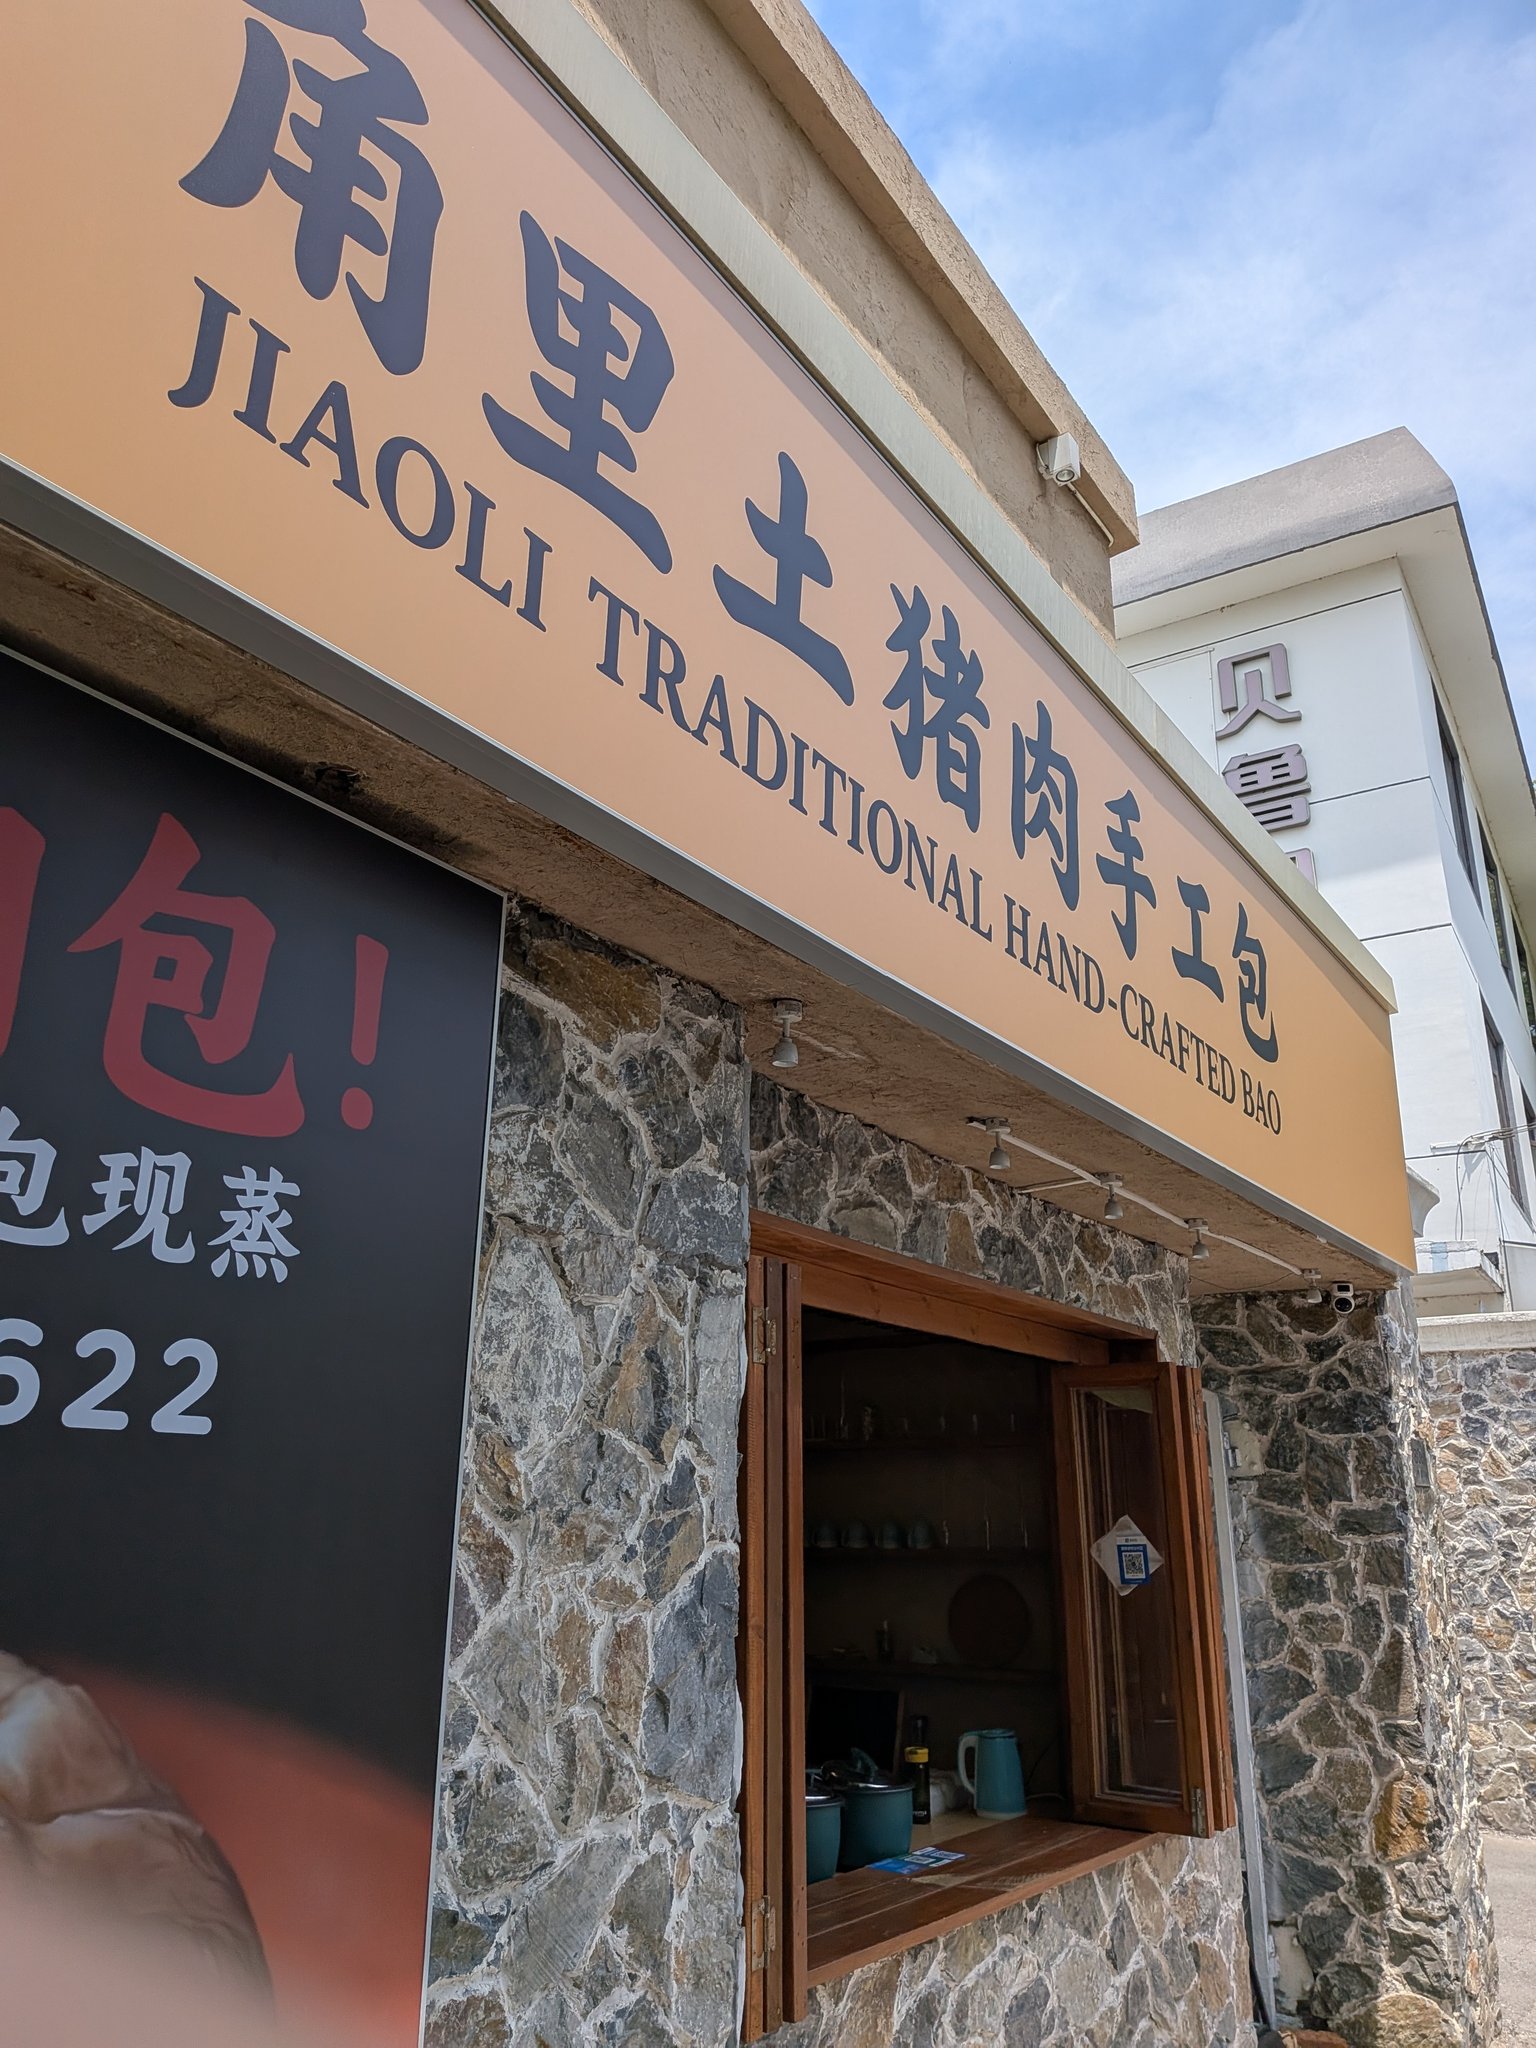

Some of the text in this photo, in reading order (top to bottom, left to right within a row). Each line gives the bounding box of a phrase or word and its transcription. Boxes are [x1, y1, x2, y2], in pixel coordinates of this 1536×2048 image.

[167, 275, 1282, 1136] JIAOLI TRADITIONAL HAND-CRAFTED BAO
[178, 0, 1279, 1063] 角里土猪肉手工包
[0, 1106, 301, 1283] 包现蒸
